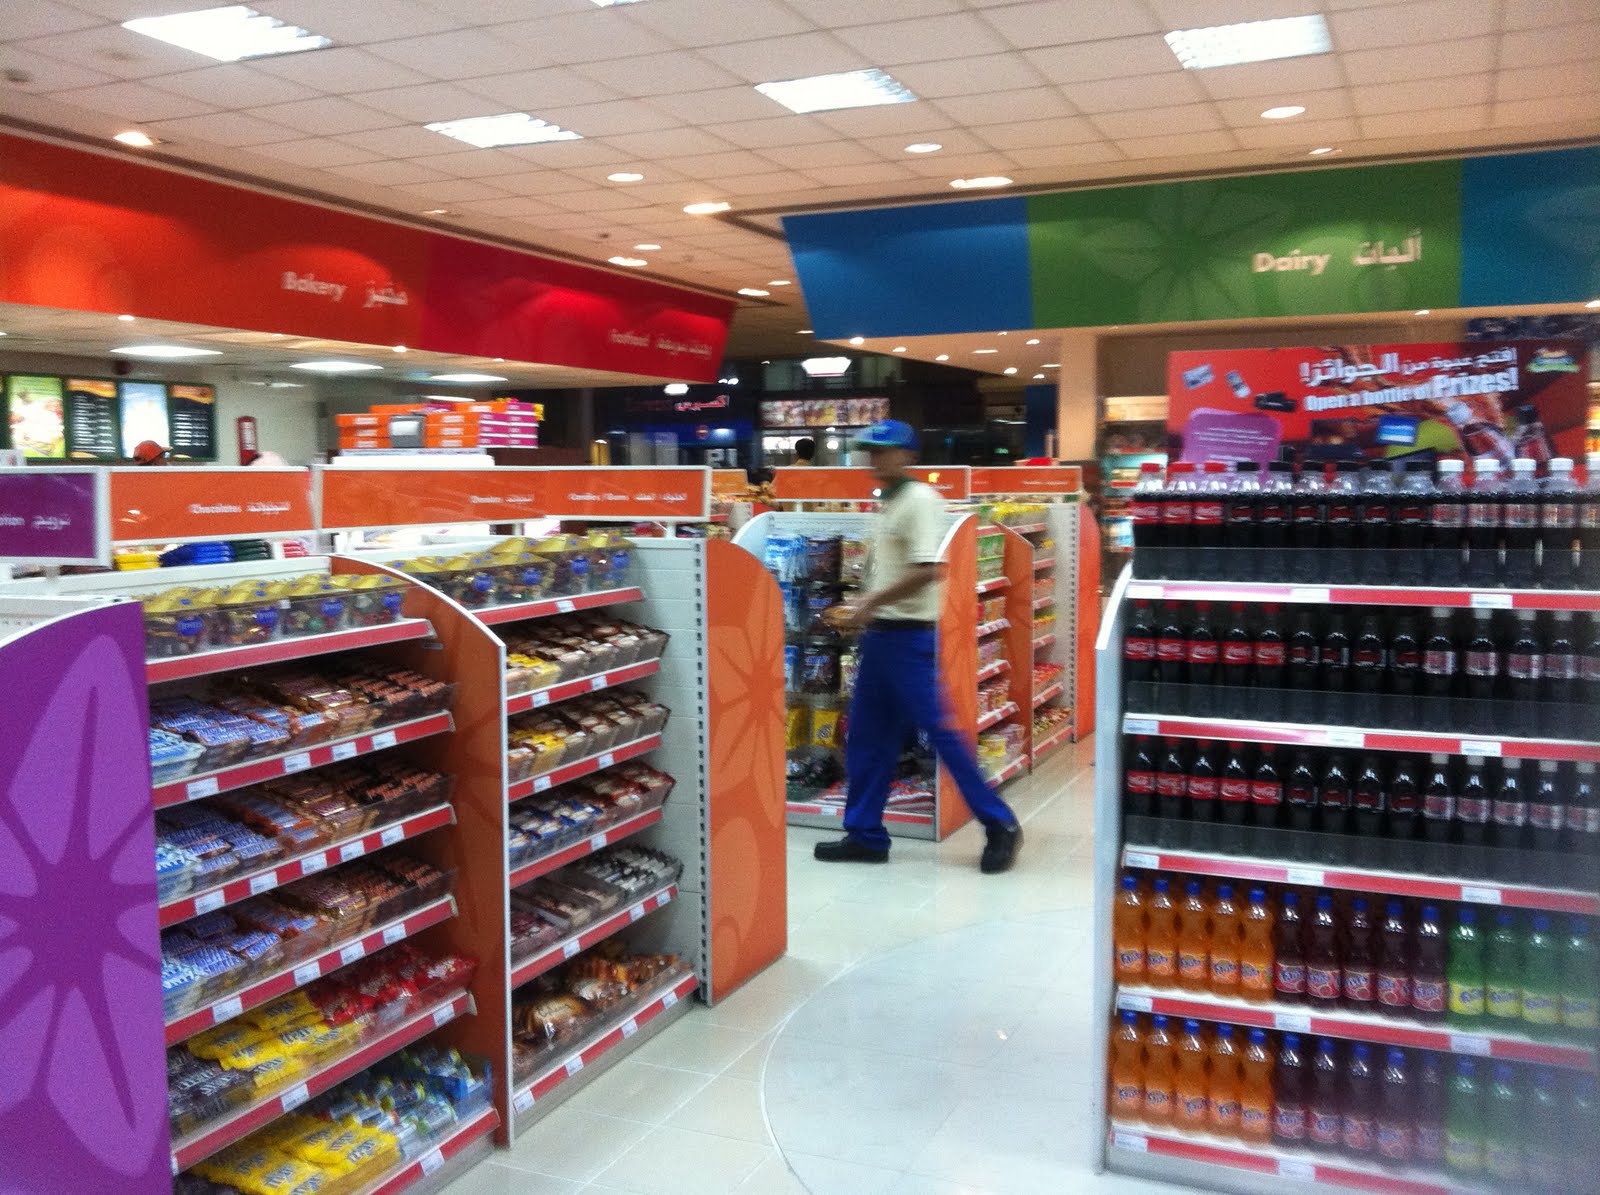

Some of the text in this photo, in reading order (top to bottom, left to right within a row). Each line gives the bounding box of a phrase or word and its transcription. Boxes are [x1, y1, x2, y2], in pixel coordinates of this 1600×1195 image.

[1252, 248, 1332, 276] Dairy
[281, 270, 348, 303] Bakery
[1304, 394, 1347, 412] Open
